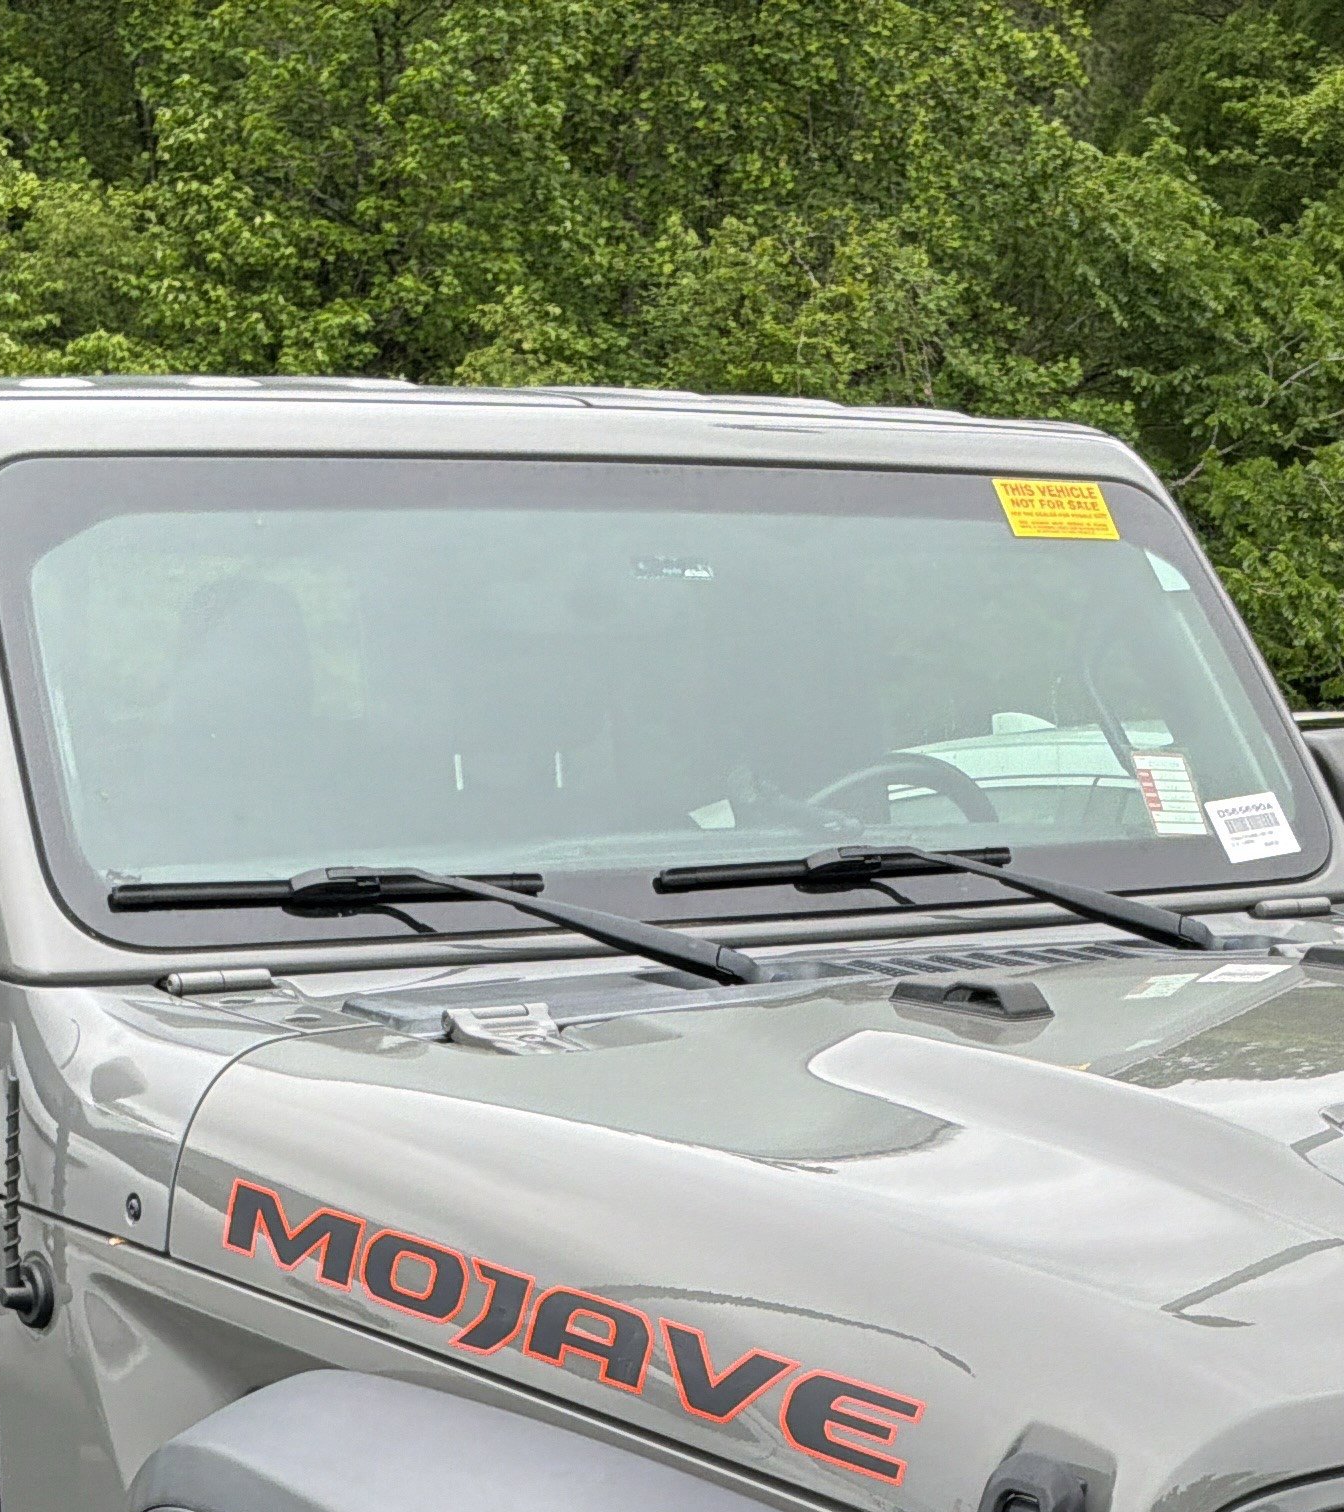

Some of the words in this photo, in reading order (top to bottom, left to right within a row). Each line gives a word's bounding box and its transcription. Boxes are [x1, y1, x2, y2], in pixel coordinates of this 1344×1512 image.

[1000, 483, 1035, 496] THIS
[1036, 485, 1098, 499] VEHICLE
[1010, 498, 1035, 509] NOT
[1038, 499, 1066, 510] FOR
[1067, 500, 1100, 511] SALE
[223, 1178, 926, 1487] MOJAVE
